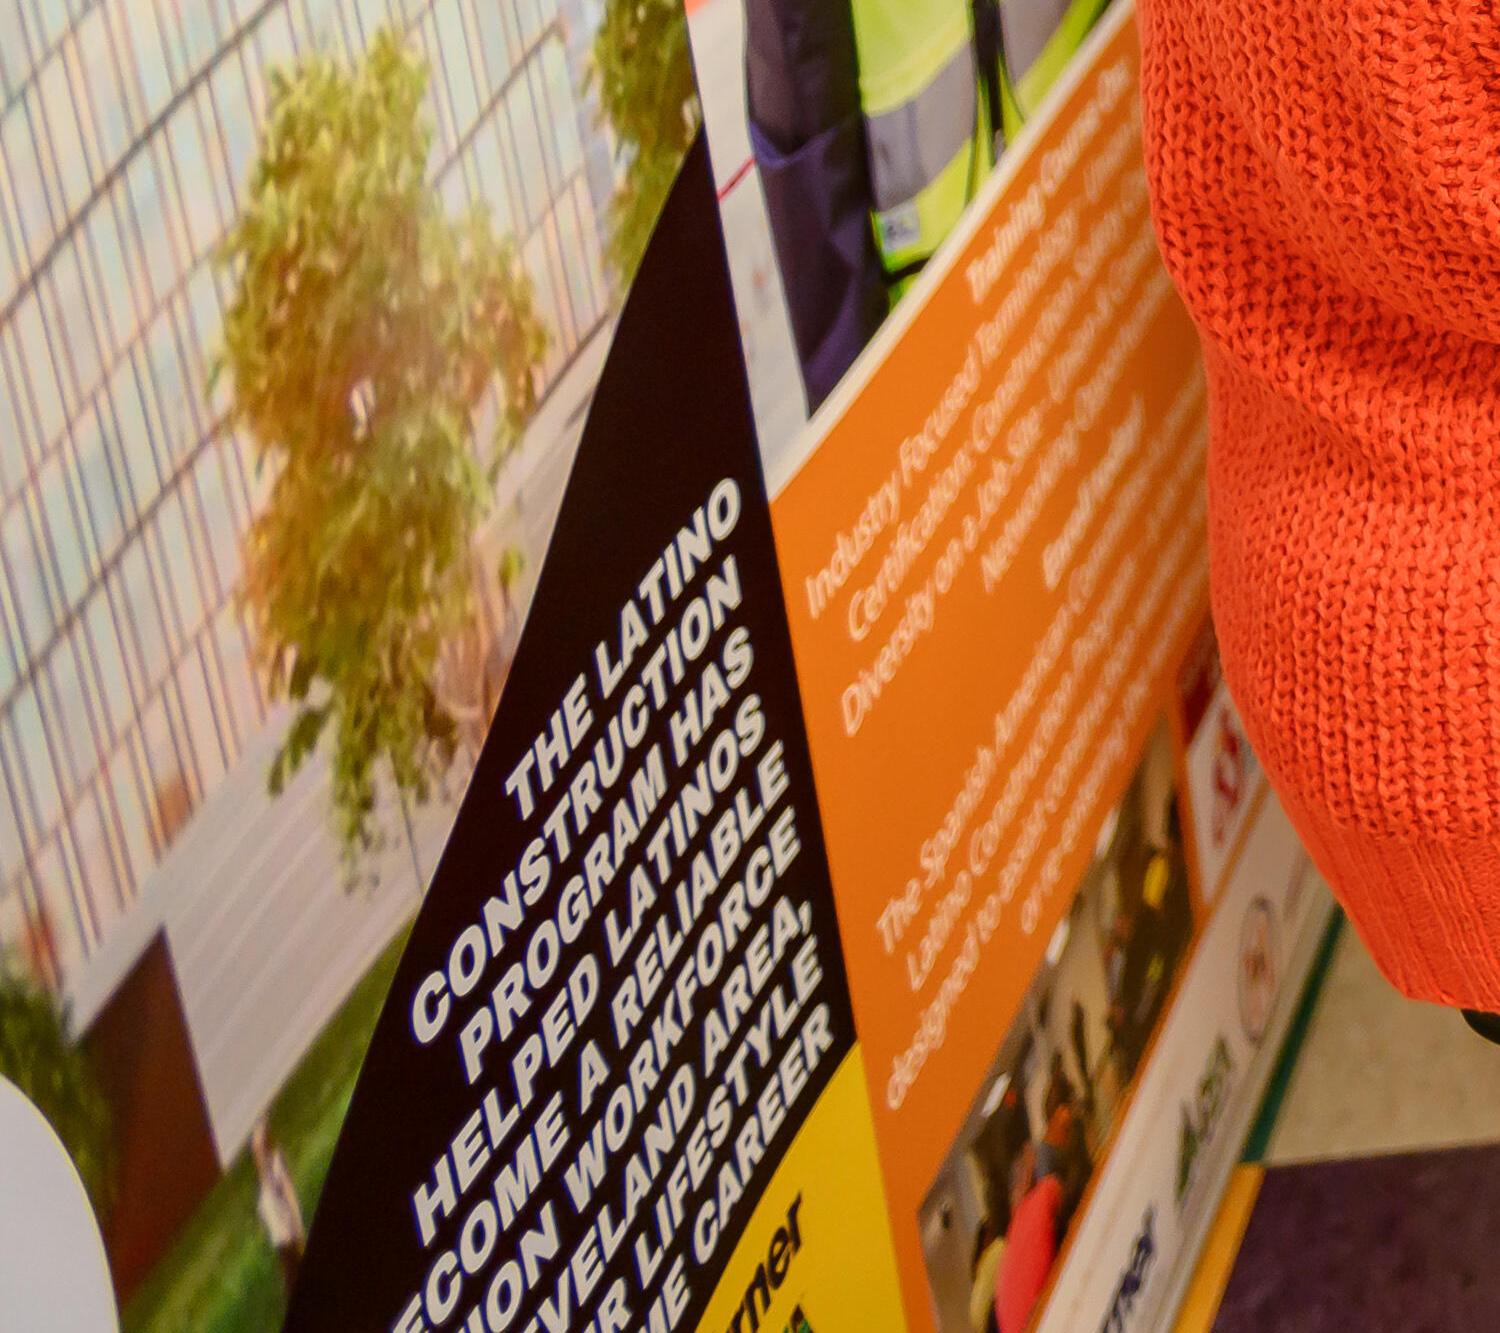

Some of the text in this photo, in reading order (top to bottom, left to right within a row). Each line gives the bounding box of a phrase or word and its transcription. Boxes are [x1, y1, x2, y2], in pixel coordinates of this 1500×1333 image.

[506, 478, 741, 821] THE LATINO
[805, 472, 899, 617] Industry
[899, 335, 978, 485] Focused
[841, 581, 934, 735] Diversity
[411, 554, 743, 1045] CONSTRUCTION
[412, 695, 766, 1247] HELPED LATINOS
[459, 626, 755, 1085] PROGRAM HAS
[390, 739, 790, 1333] COME A RELIABLE
[523, 895, 812, 1333] VELAND AREA,
[564, 805, 801, 1214] WORKFORCE
[634, 934, 824, 1290] LIFESTYLE
[694, 1002, 834, 1265] CAREER
